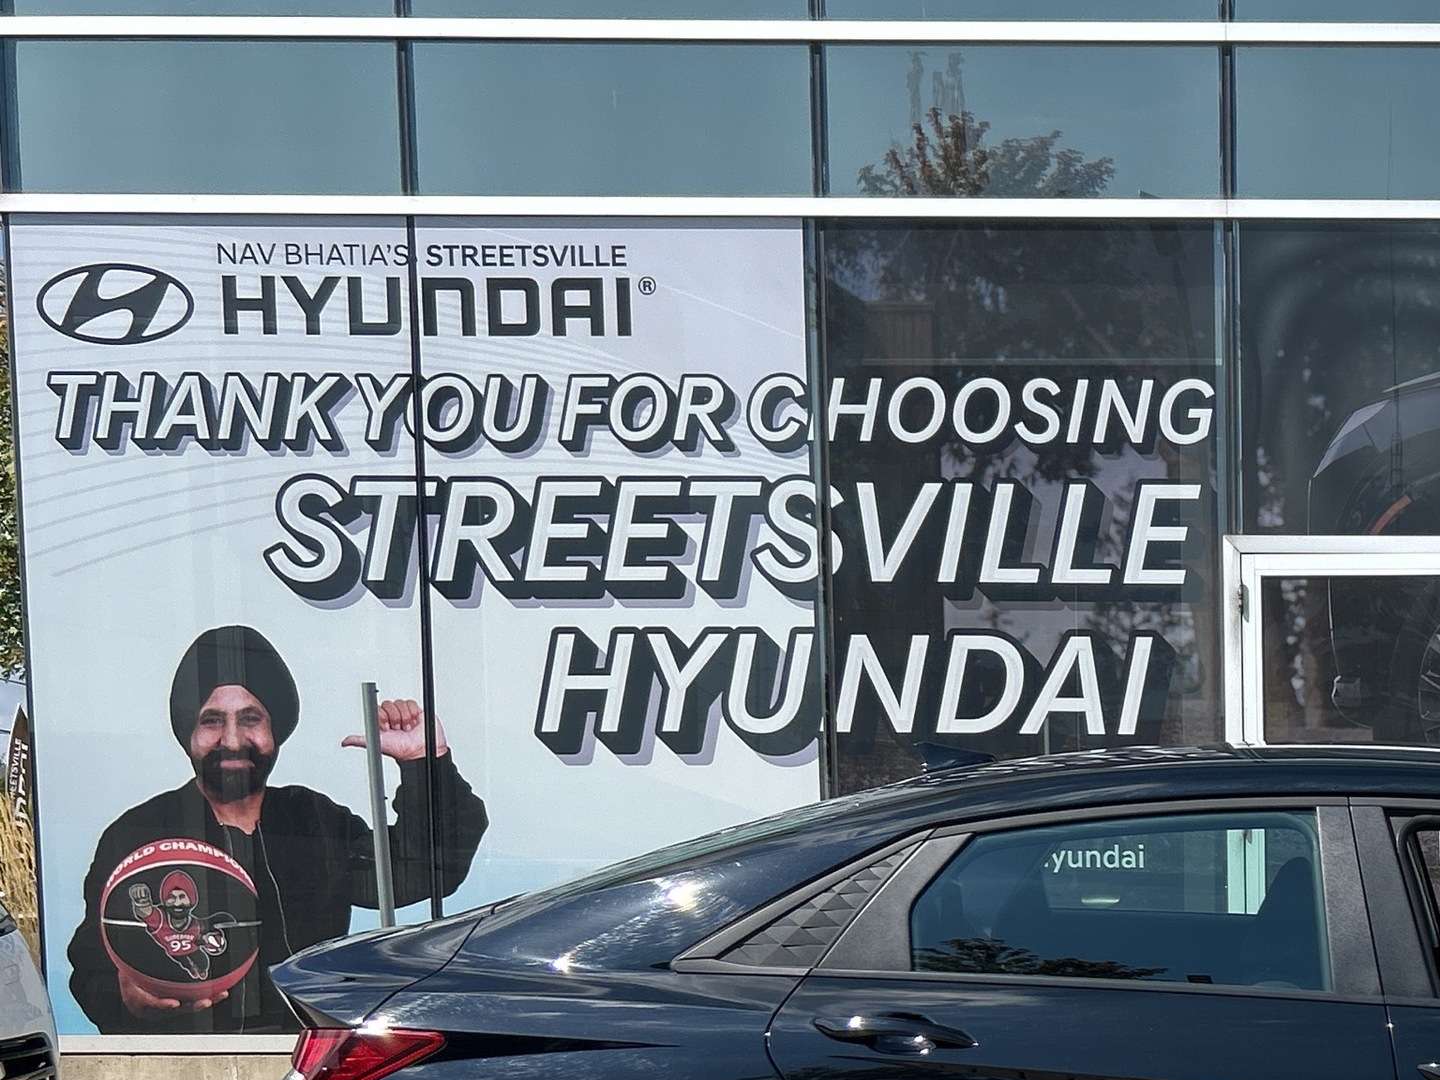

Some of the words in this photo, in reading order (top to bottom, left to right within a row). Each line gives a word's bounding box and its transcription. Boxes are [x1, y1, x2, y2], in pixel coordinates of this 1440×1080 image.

[216, 242, 277, 266] NAV
[284, 242, 411, 267] BHATIA'S
[425, 244, 628, 267] STREETSVILLE
[47, 371, 352, 450] THANK
[355, 372, 550, 451] YOU
[559, 372, 738, 453] FOR
[746, 373, 1216, 452] CHOOSING
[264, 474, 1203, 596] STREETSVILLE
[536, 628, 1165, 748] HYUNDAI
[1044, 844, 1145, 873] yundai
[170, 940, 192, 952] 95
